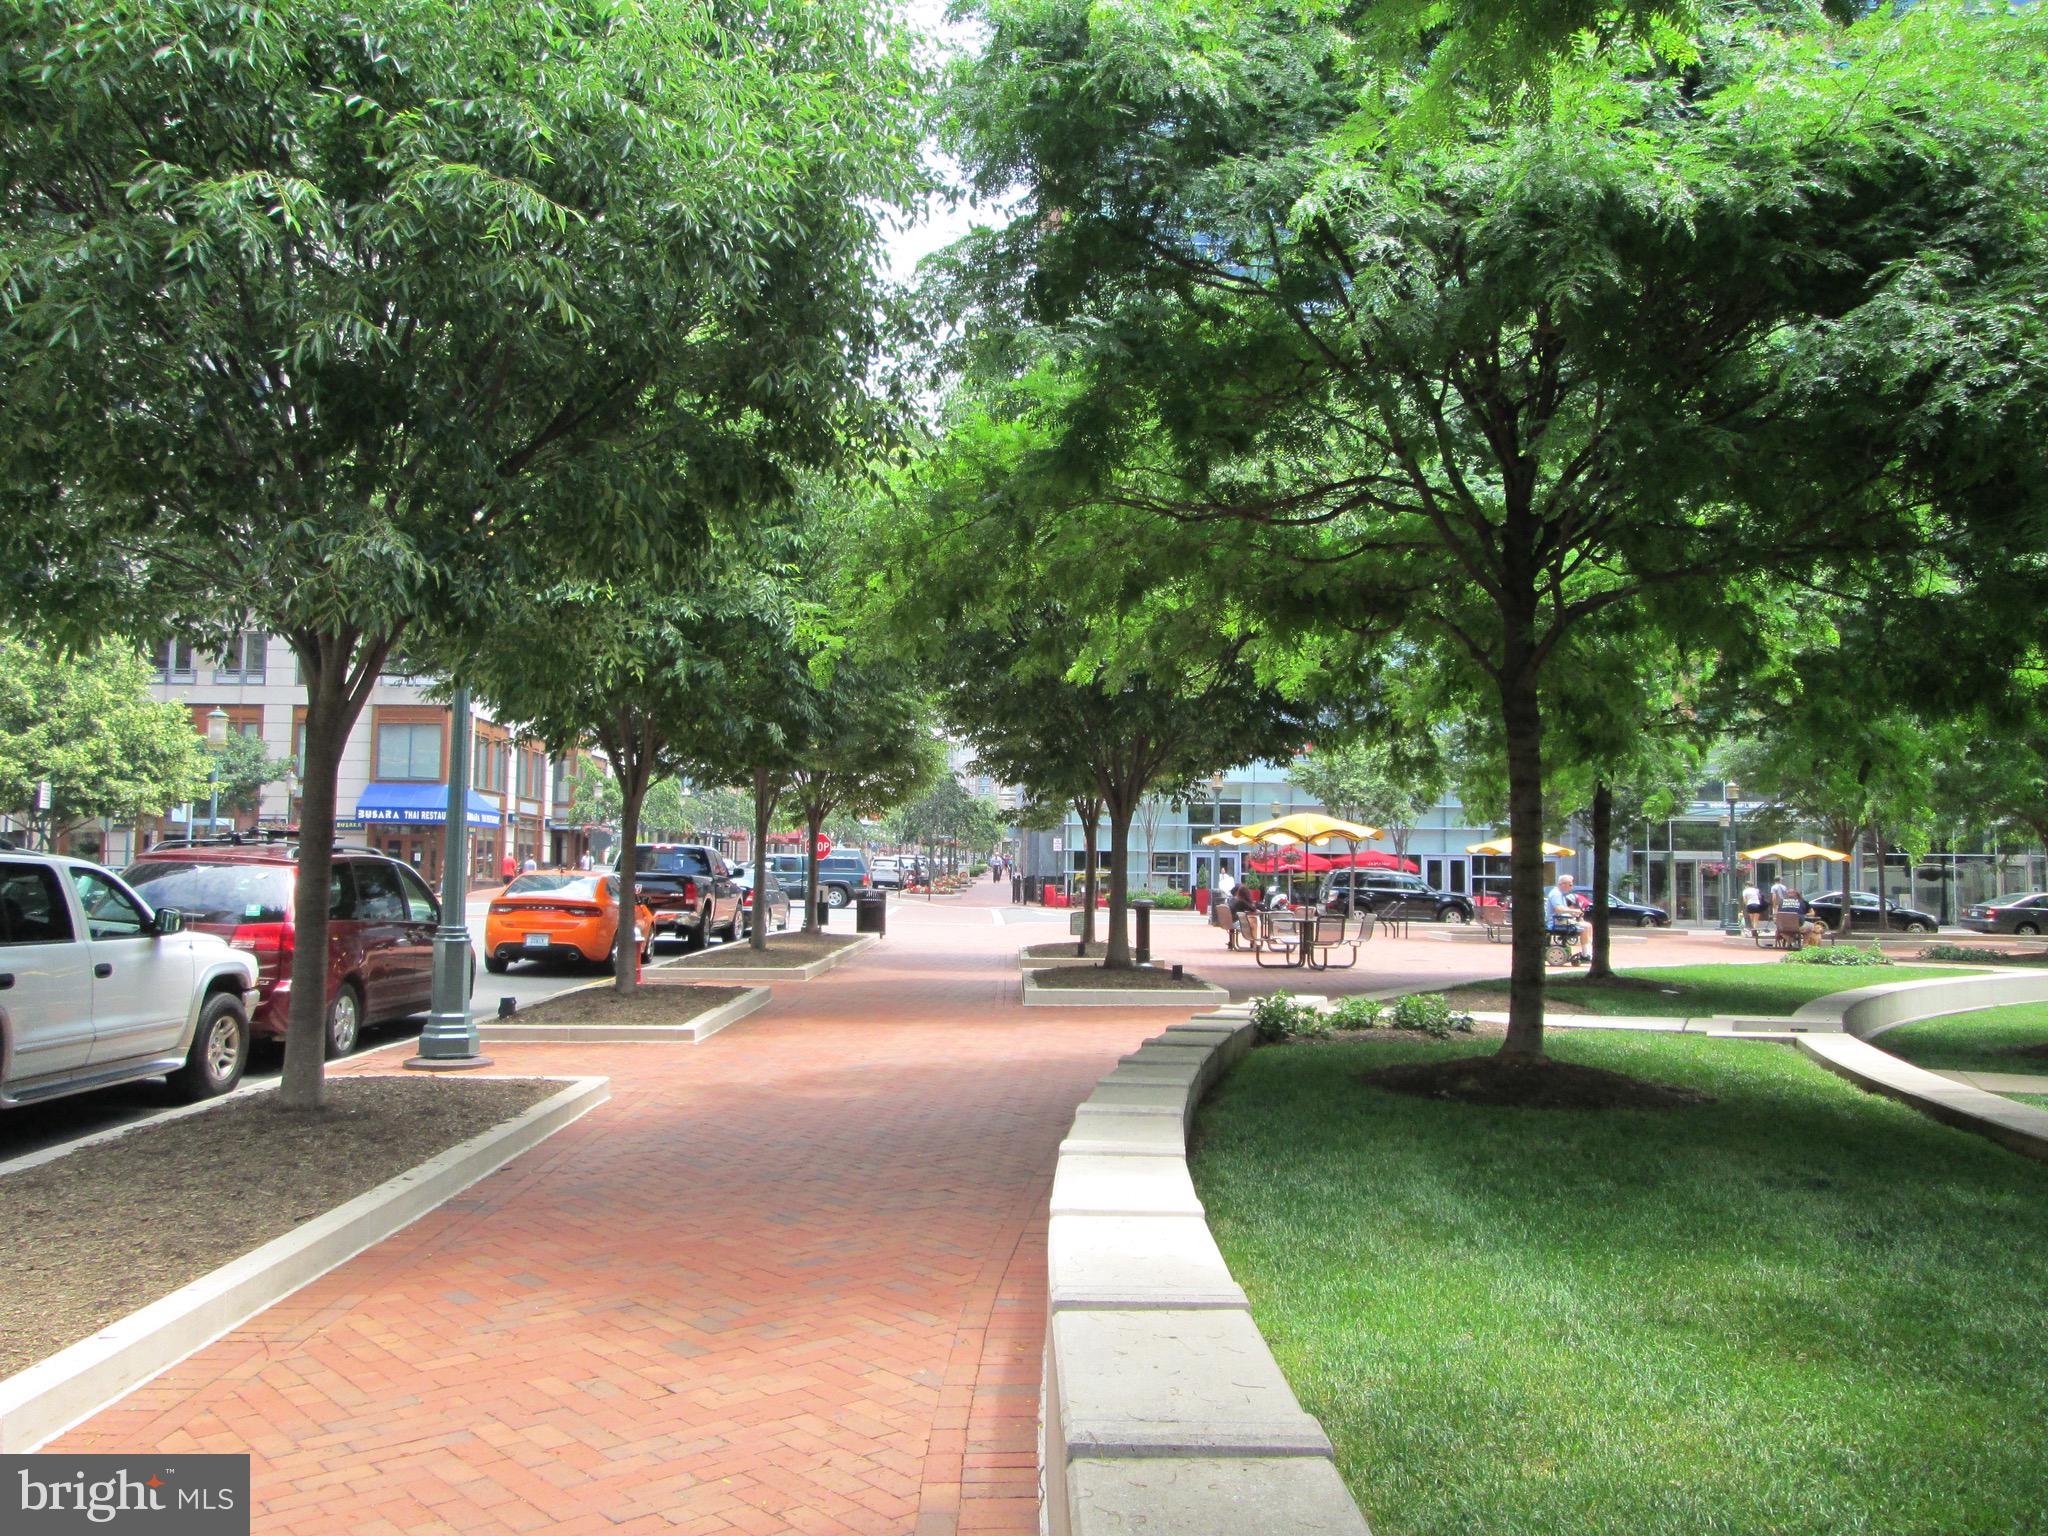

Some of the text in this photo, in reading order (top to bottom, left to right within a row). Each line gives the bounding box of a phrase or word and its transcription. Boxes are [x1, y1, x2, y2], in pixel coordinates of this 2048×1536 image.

[358, 809, 447, 821] BUSARA THAI RESTAU
